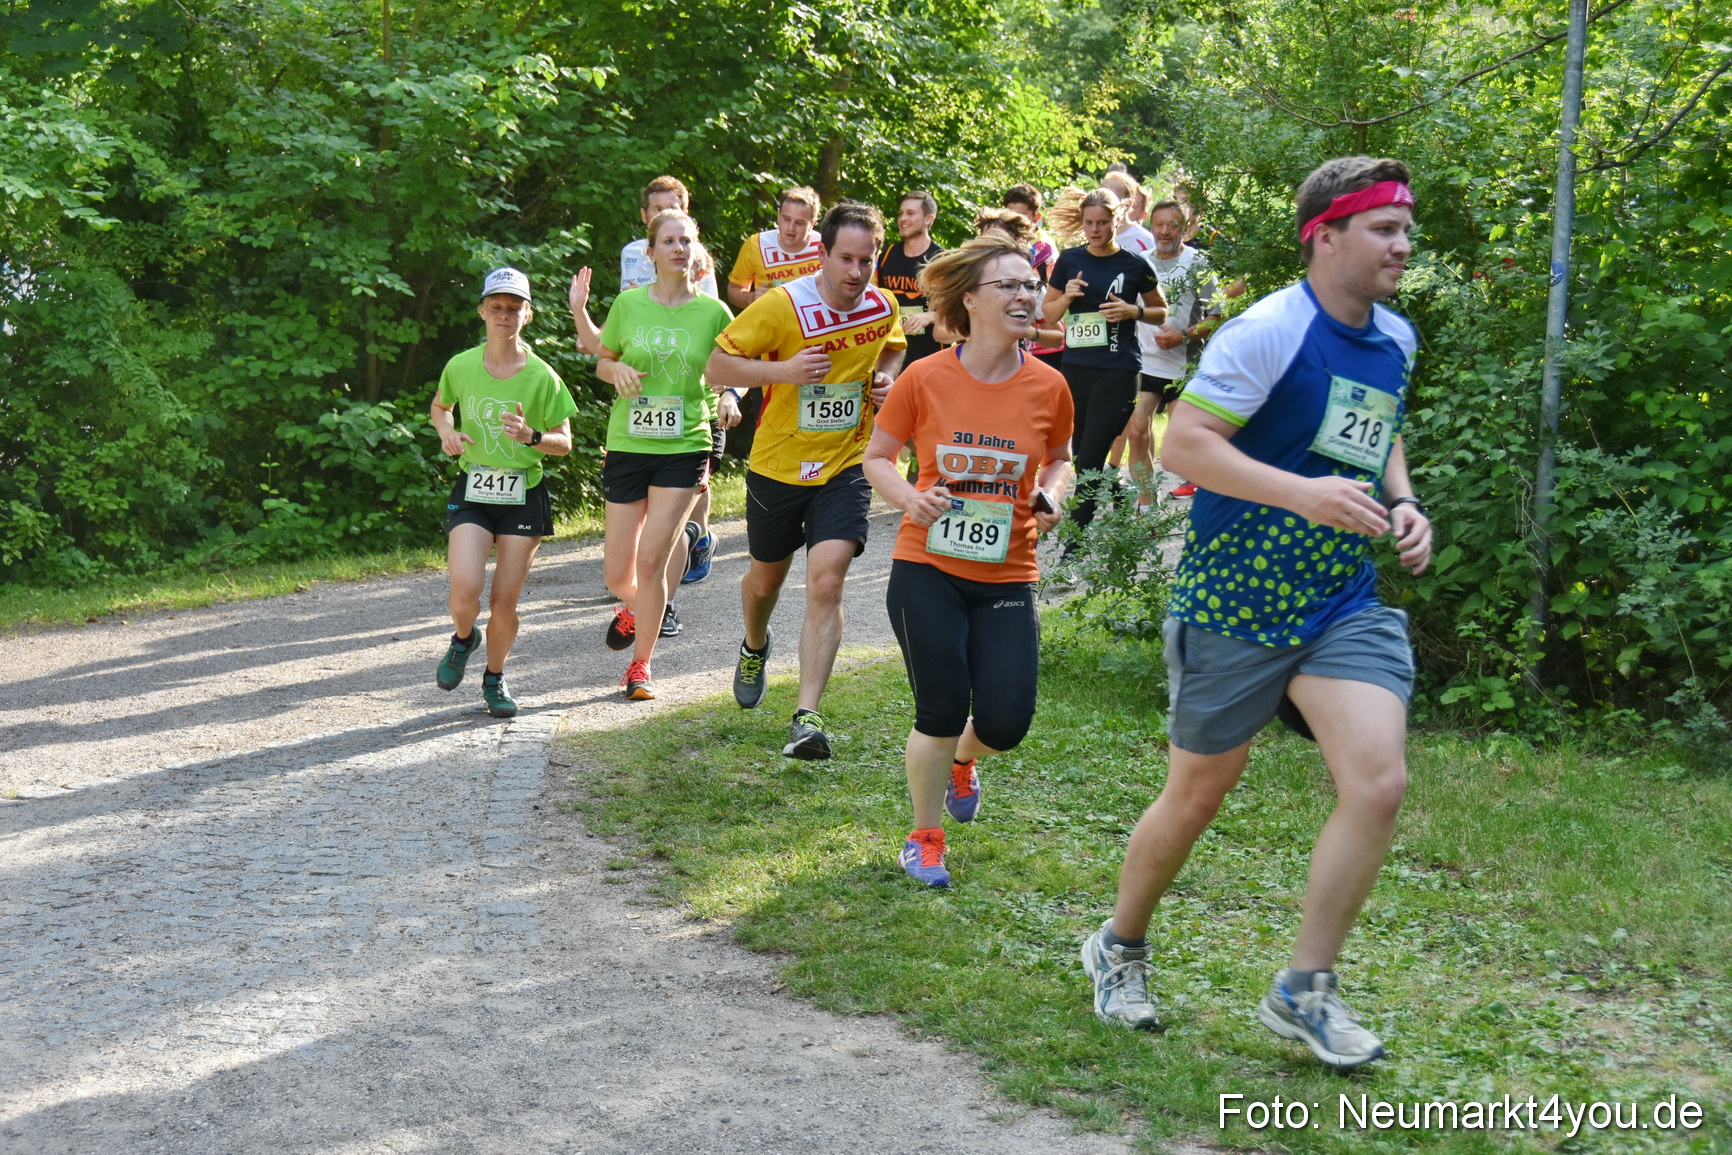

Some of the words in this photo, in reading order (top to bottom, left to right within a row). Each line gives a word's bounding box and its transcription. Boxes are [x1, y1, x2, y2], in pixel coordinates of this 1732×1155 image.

[766, 269, 795, 281] MAX
[854, 324, 891, 346] BÖGL
[1070, 324, 1100, 338] 1950
[807, 400, 854, 418] 1580
[633, 410, 676, 427] 2418
[1339, 411, 1383, 448] 218
[953, 431, 974, 444] 30
[977, 433, 1015, 450] Jahre
[943, 453, 1019, 475] OBI
[473, 473, 519, 491] 2417
[940, 518, 999, 546] 1189
[950, 540, 974, 549] Thomas
